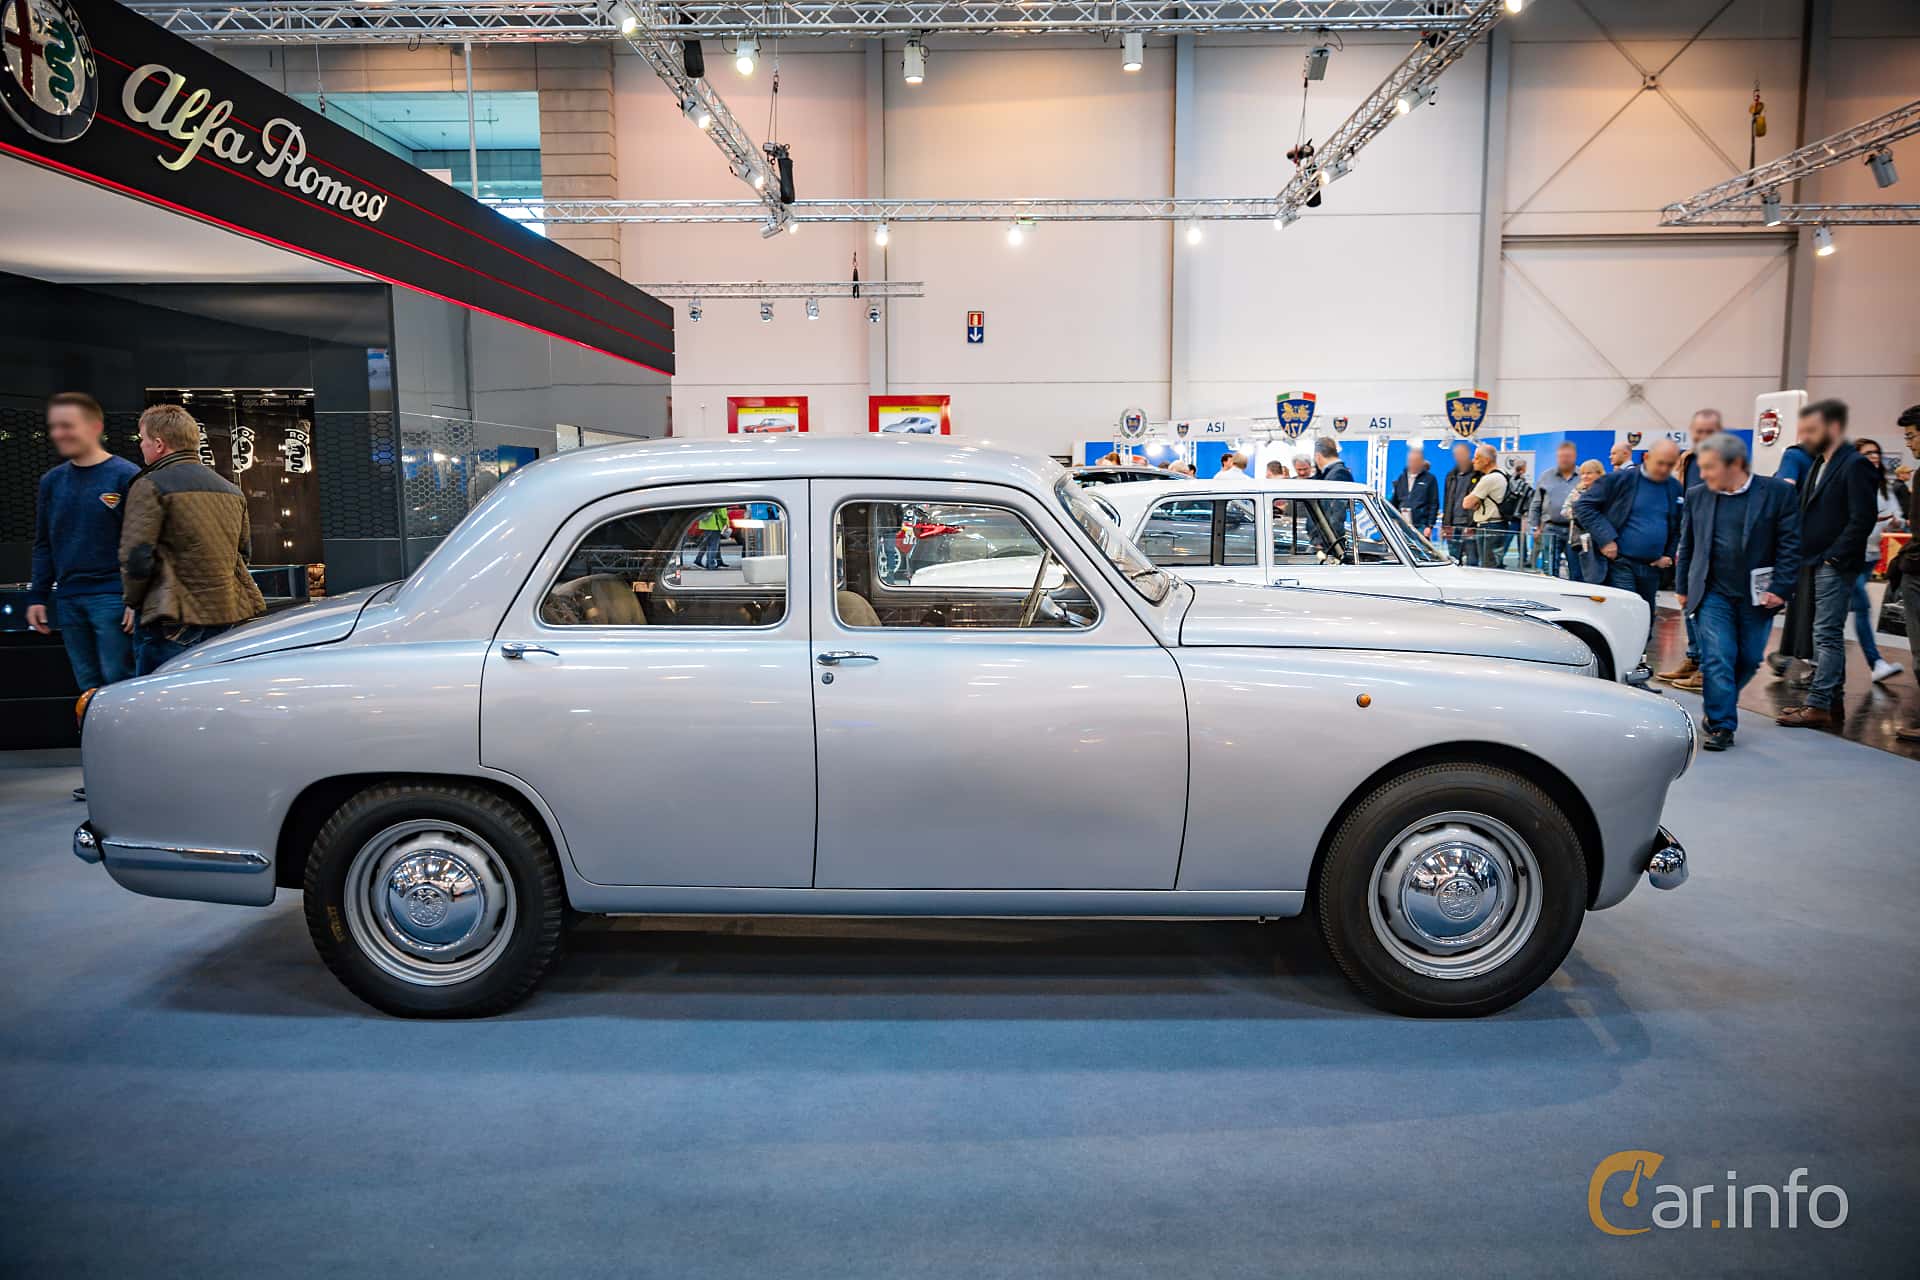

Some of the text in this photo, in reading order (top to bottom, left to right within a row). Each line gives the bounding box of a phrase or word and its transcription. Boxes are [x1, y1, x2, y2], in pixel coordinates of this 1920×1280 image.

[122, 63, 387, 222] Alfa Romeo
[1206, 422, 1225, 433] ASI
[1283, 422, 1304, 438] ASI
[1369, 417, 1391, 429] ASI
